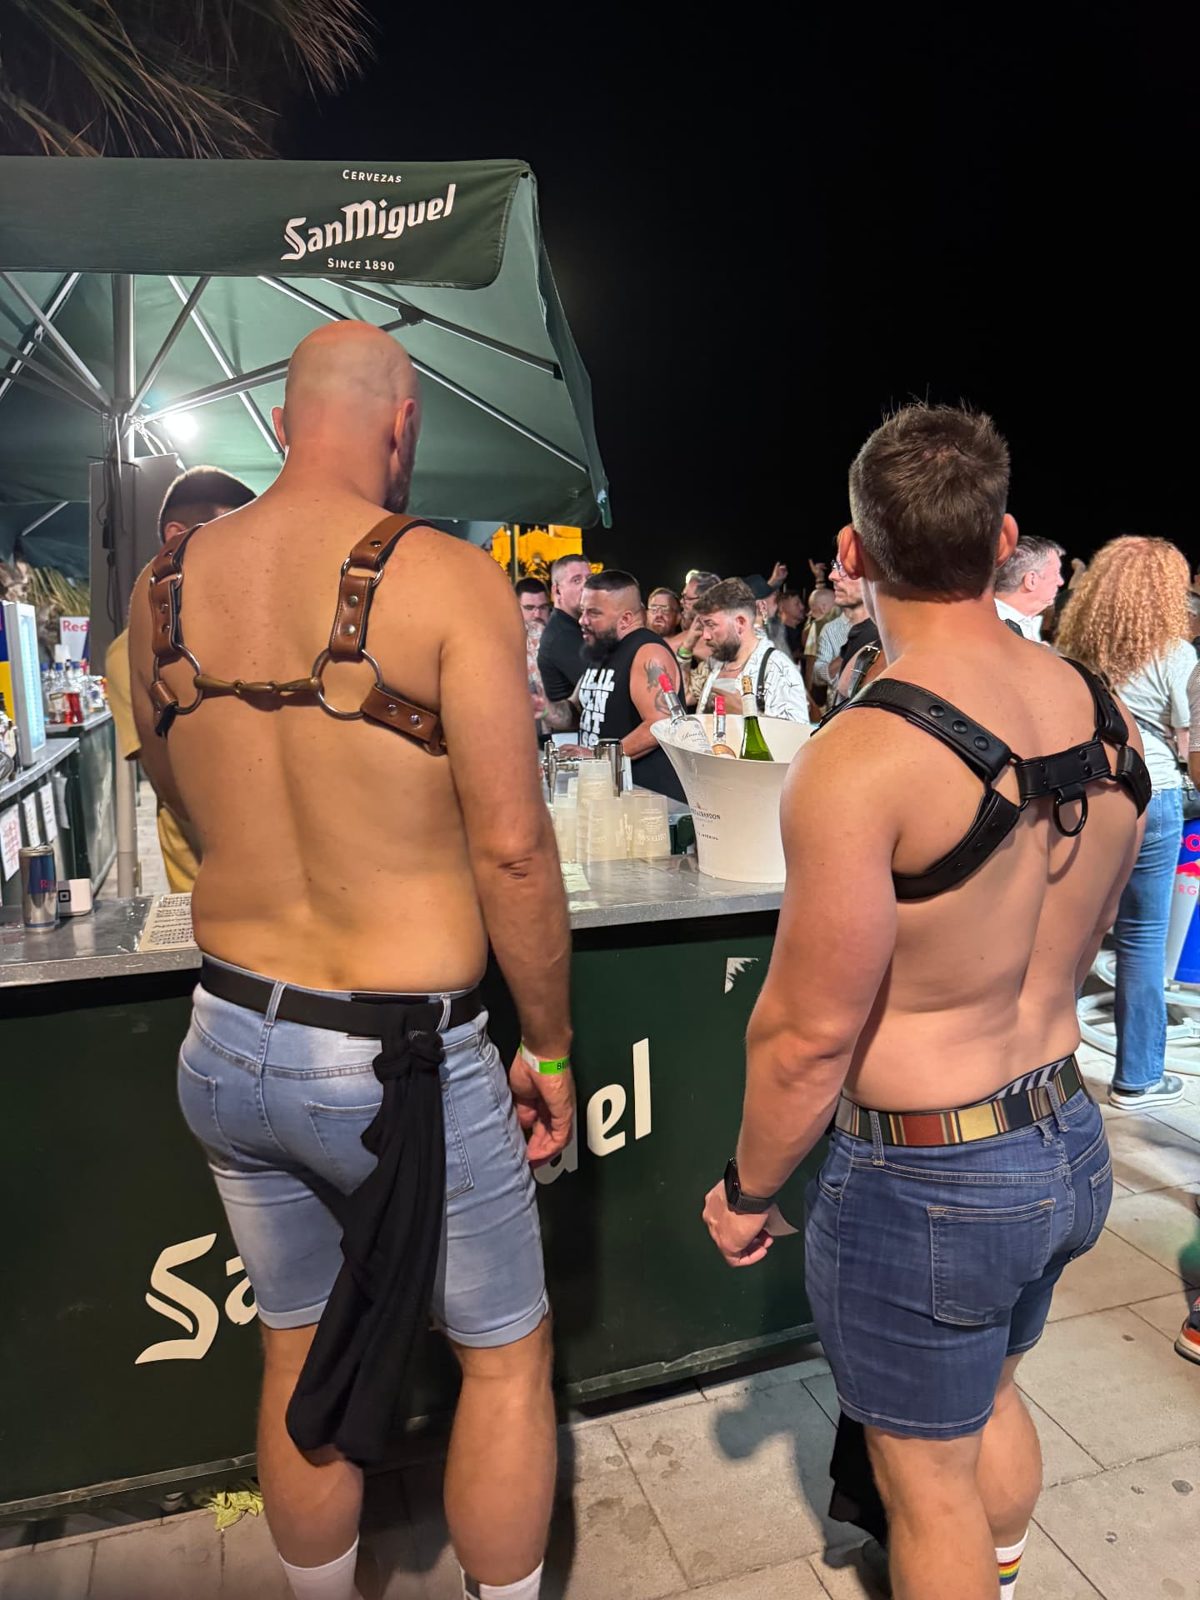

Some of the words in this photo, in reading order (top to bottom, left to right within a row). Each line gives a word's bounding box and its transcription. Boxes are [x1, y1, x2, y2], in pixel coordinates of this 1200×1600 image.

[342, 169, 402, 183] CERVEZAS
[327, 257, 361, 270] SINCE
[364, 259, 395, 272] 1890
[62, 620, 89, 632] Red
[134, 1232, 258, 1365] Sa
